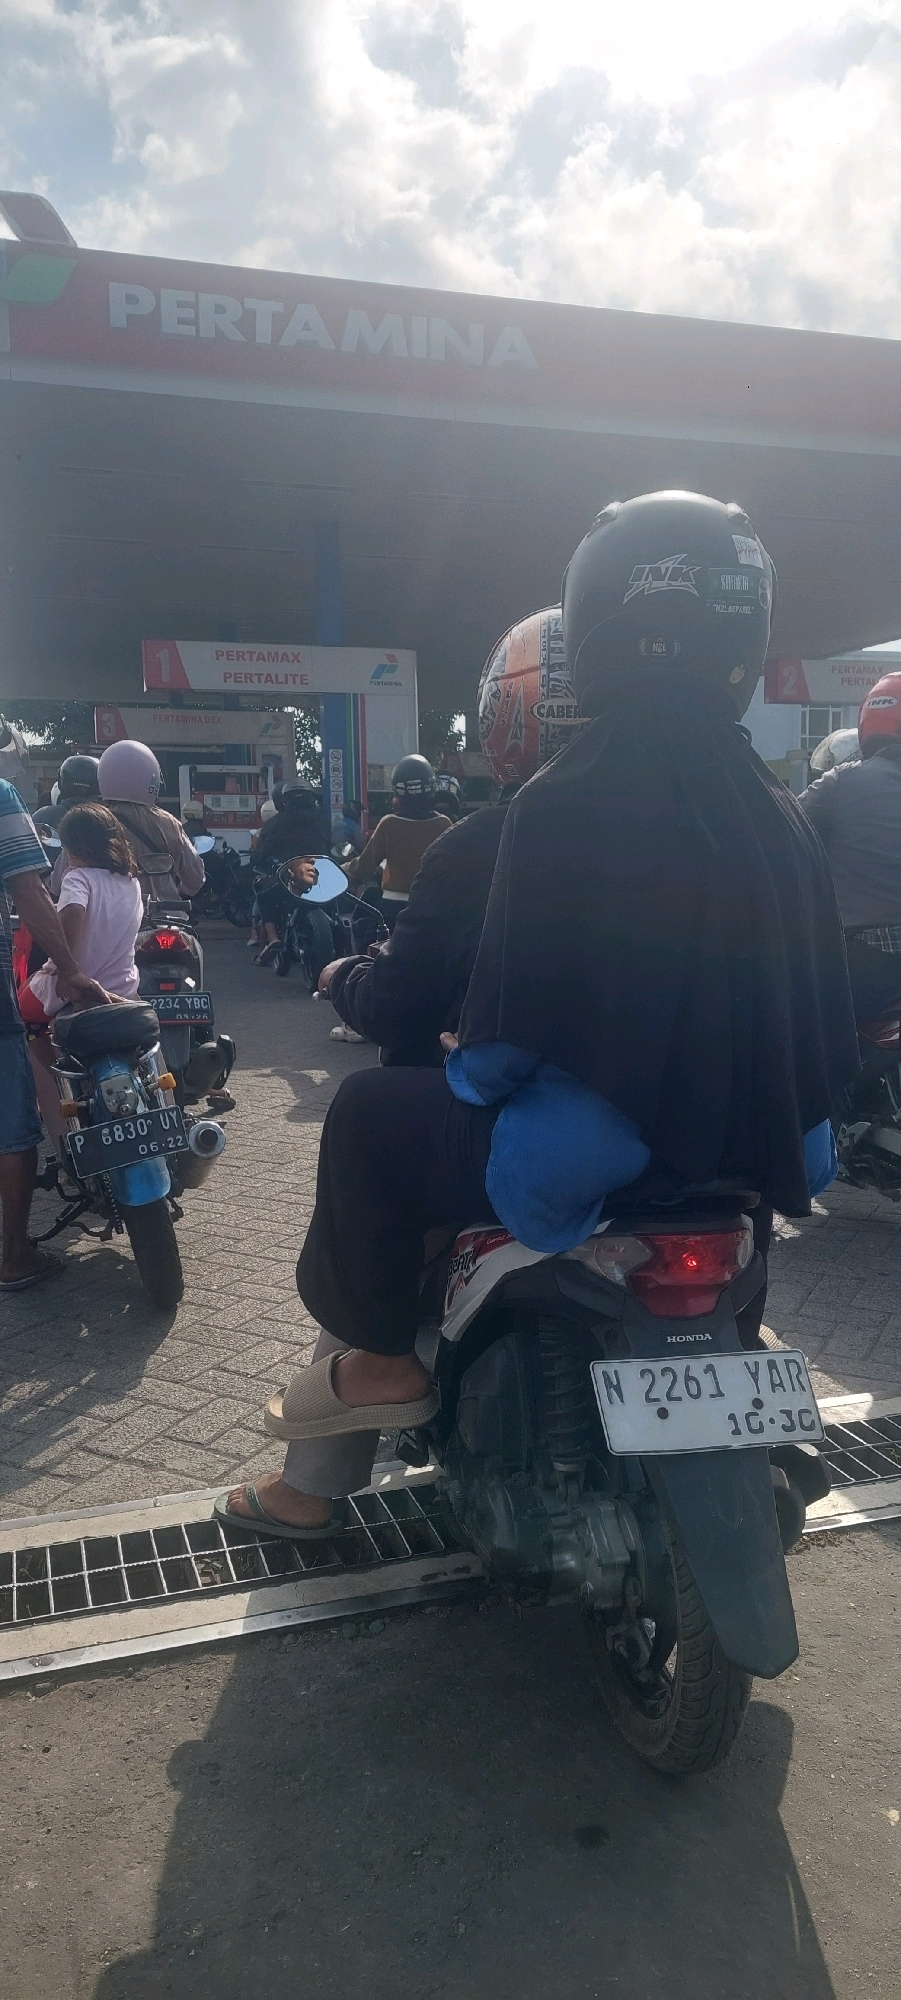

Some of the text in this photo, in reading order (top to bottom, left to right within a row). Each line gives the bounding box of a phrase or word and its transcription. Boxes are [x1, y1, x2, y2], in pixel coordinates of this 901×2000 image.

[108, 281, 540, 370] PERTAMINA
[215, 649, 302, 664] PERTAMAX
[155, 648, 170, 683] 1
[831, 665, 884, 675] PERTAMAX
[223, 671, 310, 686] PERTALITE
[782, 666, 798, 696] 2
[152, 713, 205, 725] PERTAMINA
[536, 703, 583, 719] CABER
[101, 712, 118, 737] 3
[151, 997, 209, 1010] 2234 YBC
[74, 1109, 179, 1154] P 6830 UY
[666, 1333, 713, 1343] HONDA
[602, 1358, 806, 1405] N 2261 YAR
